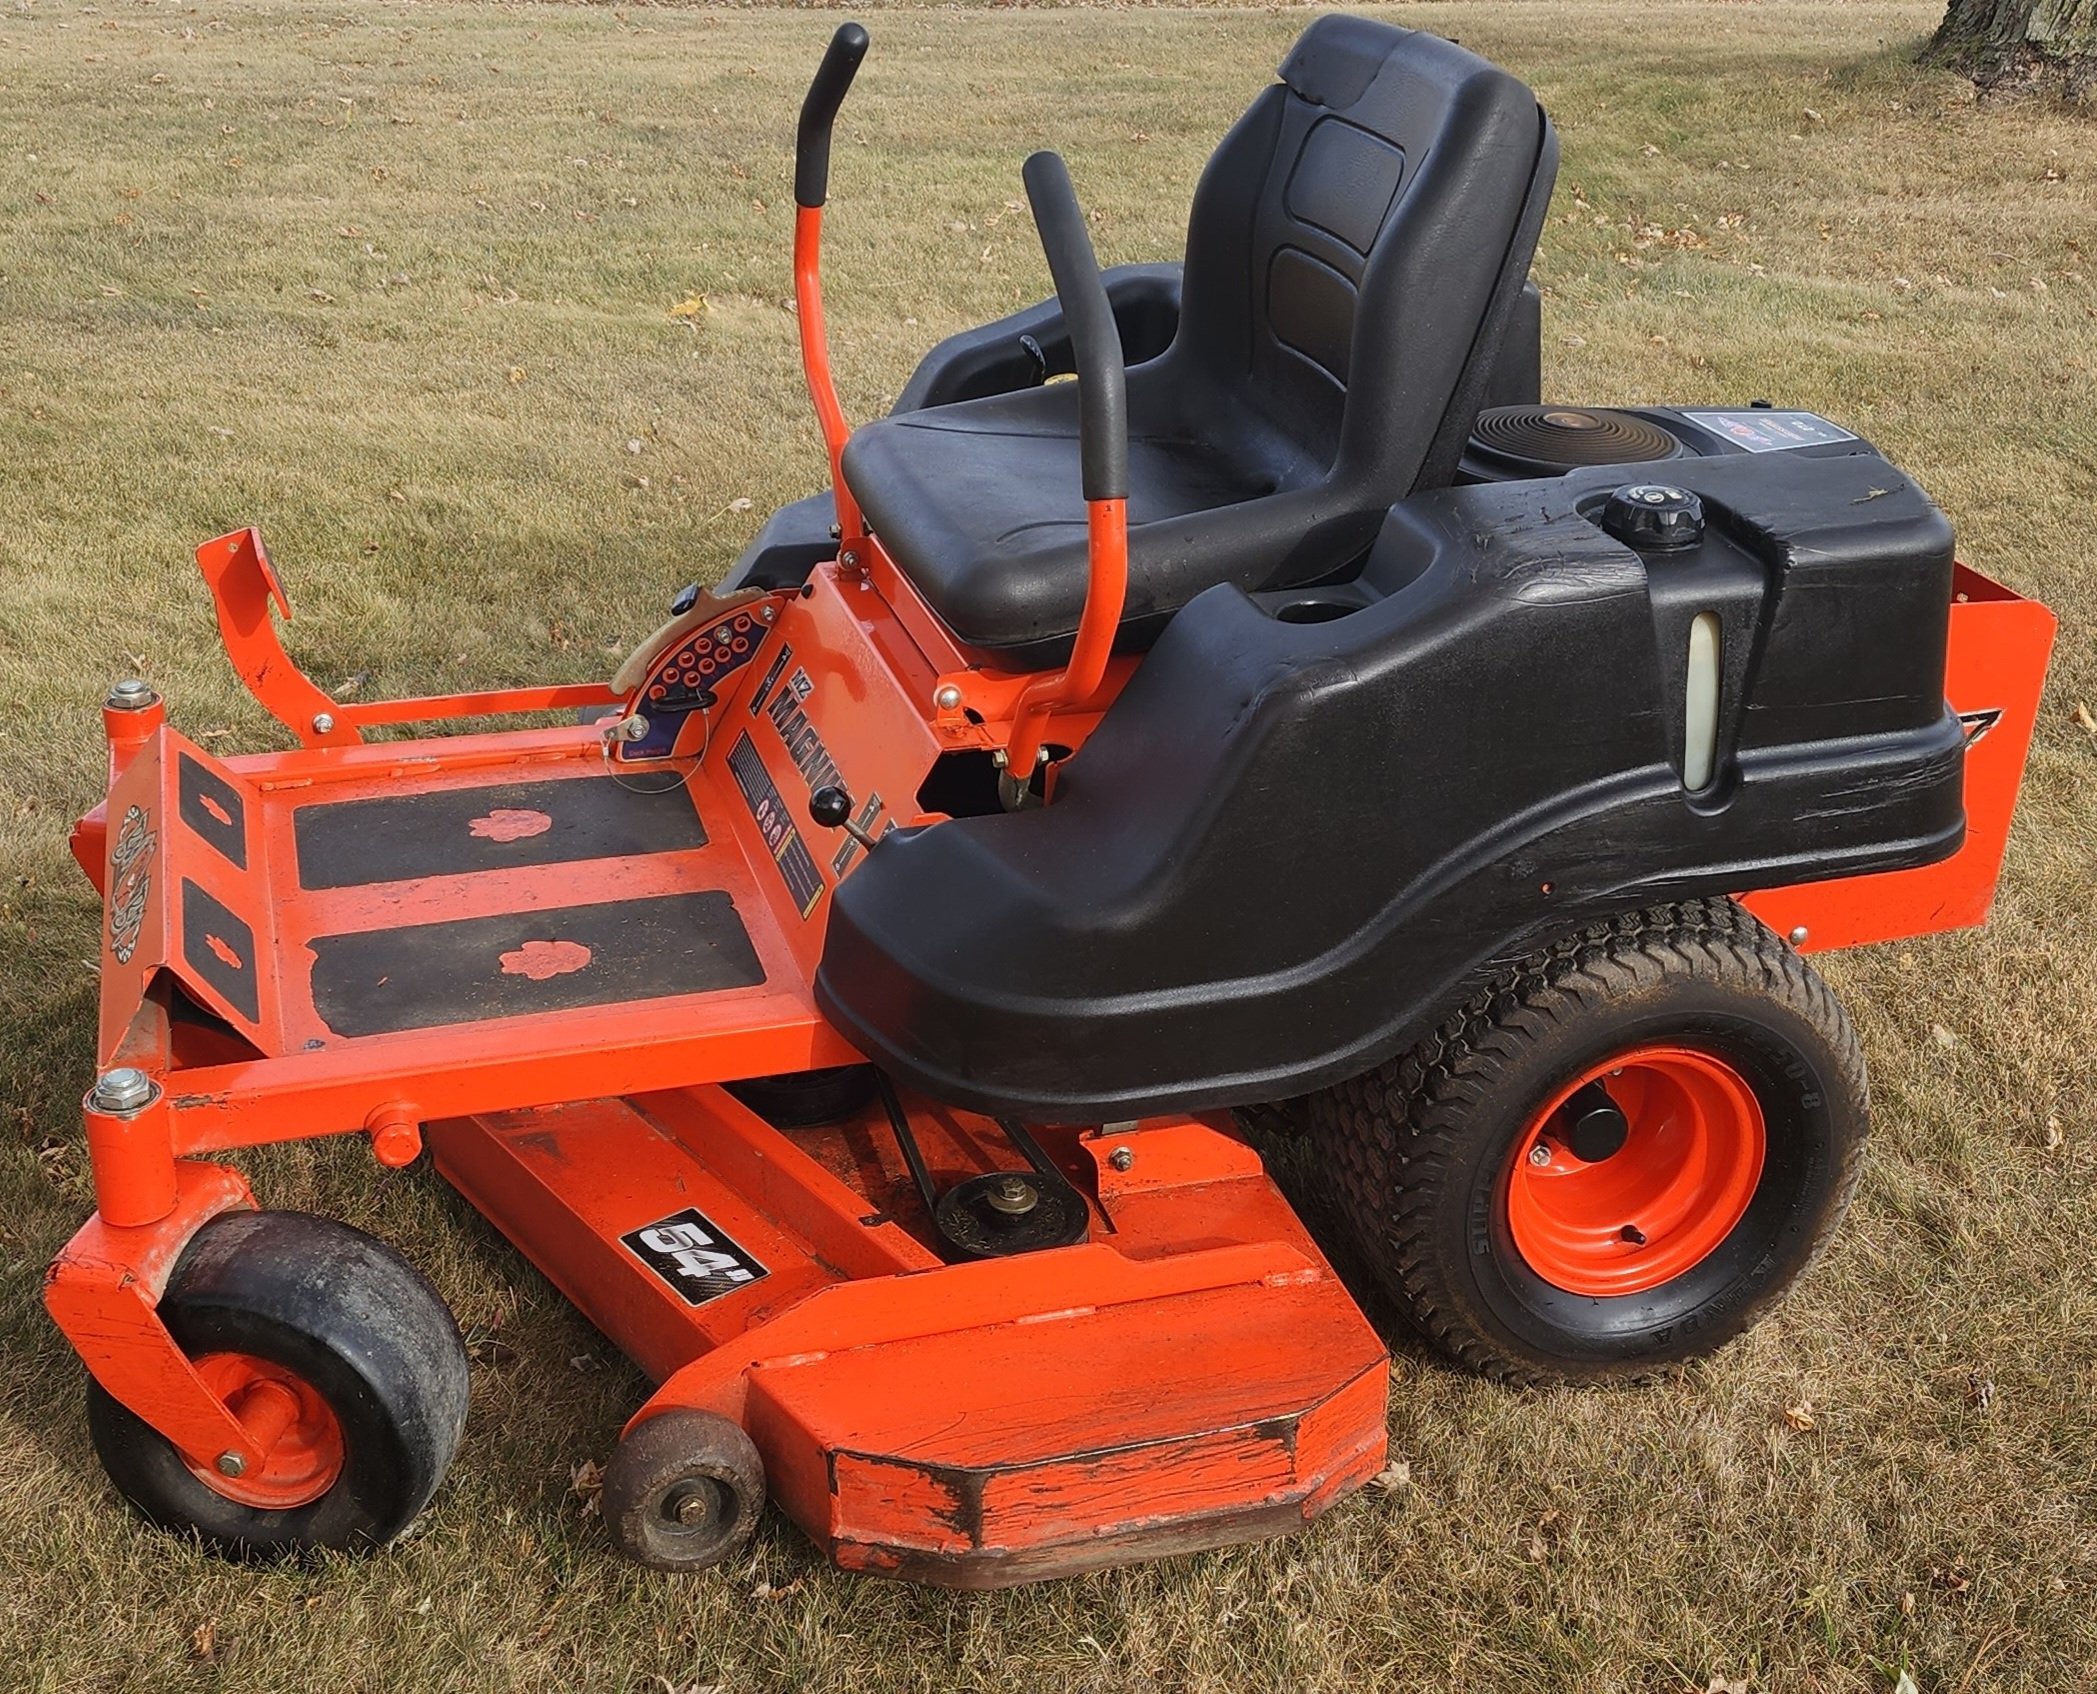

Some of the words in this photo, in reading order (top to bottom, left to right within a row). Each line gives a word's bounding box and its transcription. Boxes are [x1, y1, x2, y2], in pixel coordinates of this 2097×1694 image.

[790, 669, 812, 700] MZ
[766, 684, 857, 815] MAGNU
[639, 1222, 755, 1283] 54"
